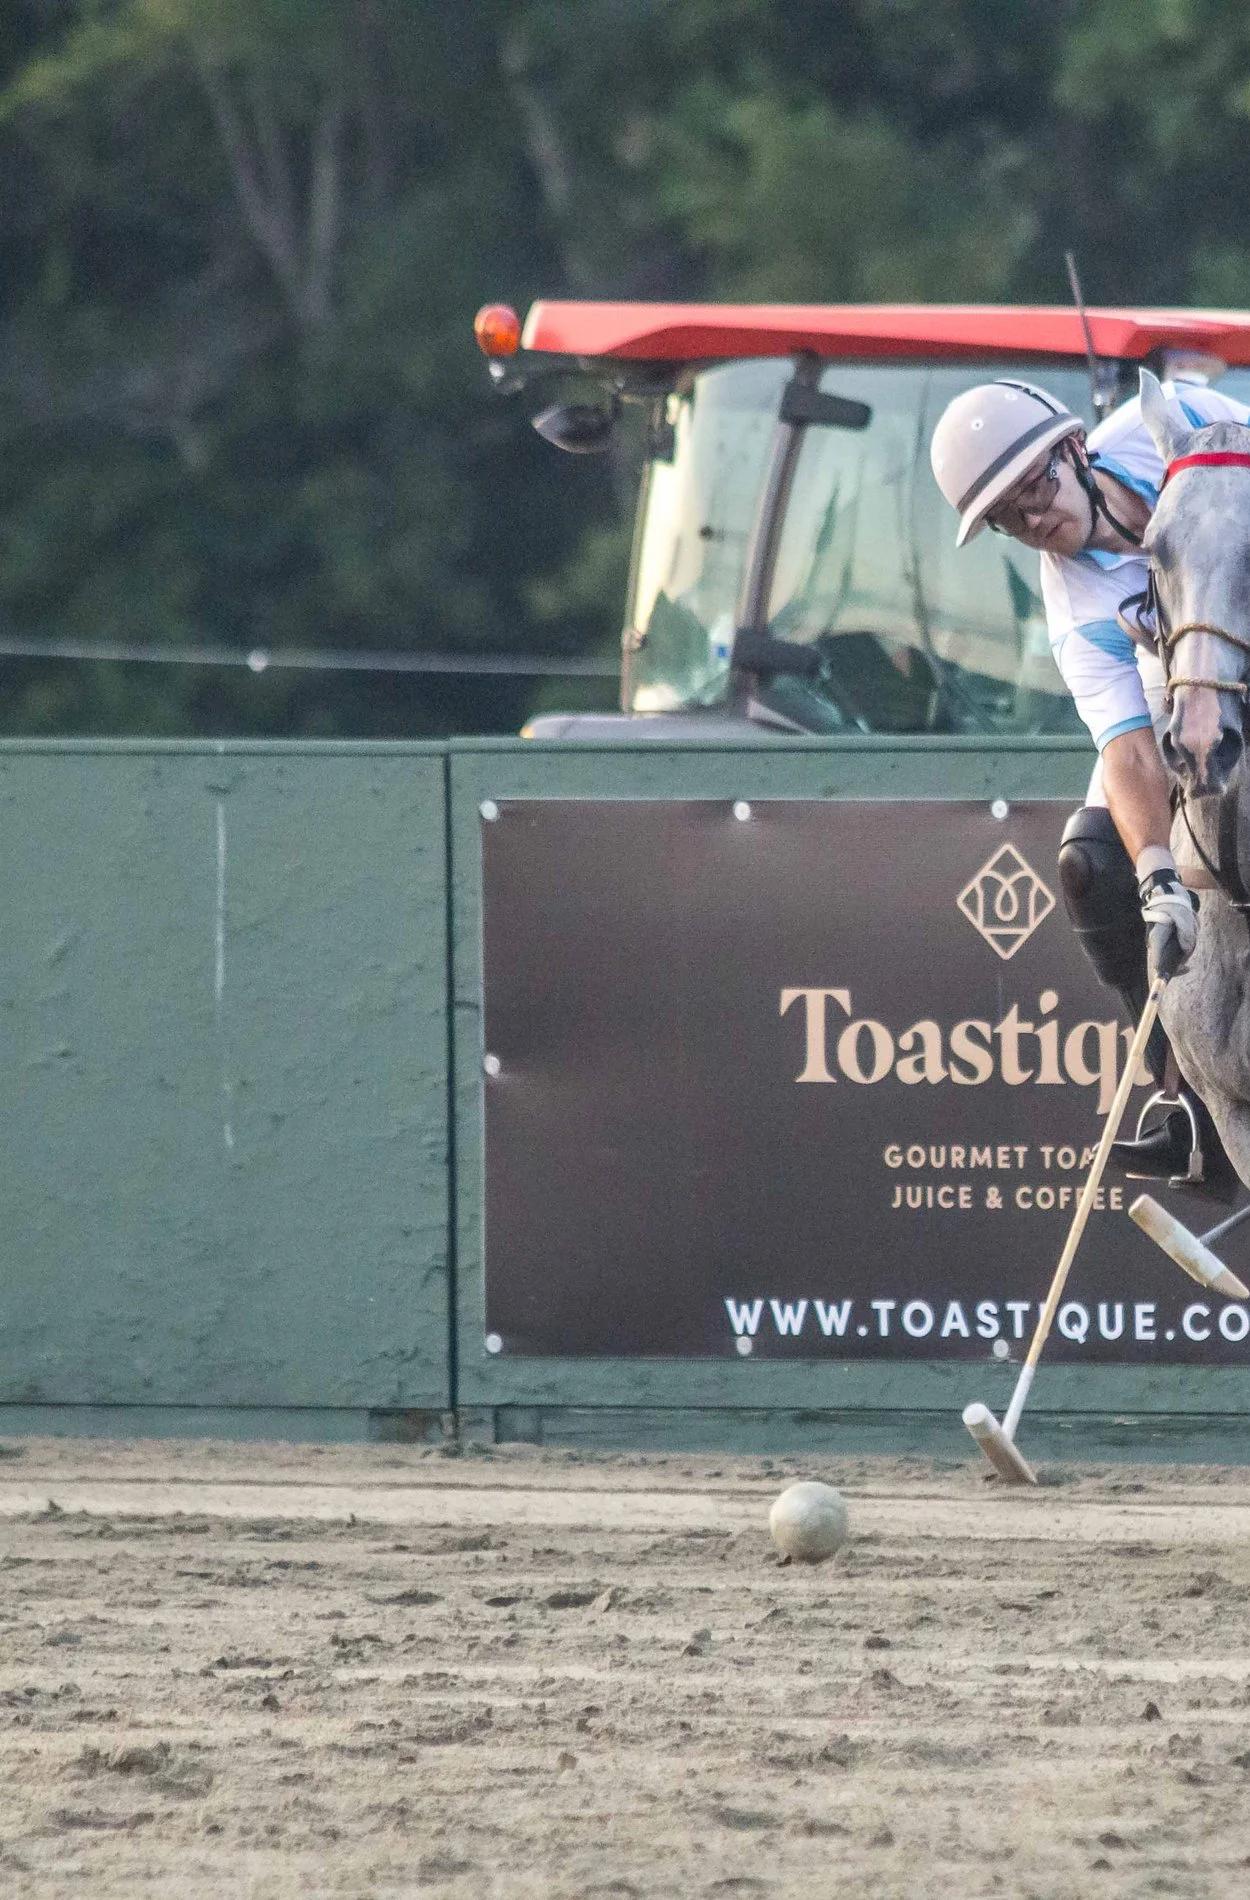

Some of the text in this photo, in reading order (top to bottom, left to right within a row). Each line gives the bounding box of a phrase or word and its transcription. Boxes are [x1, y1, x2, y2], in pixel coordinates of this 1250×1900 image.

[884, 1144, 1029, 1170] GOURMET
[891, 1185, 974, 1210] JUICE
[985, 1187, 1003, 1210] &
